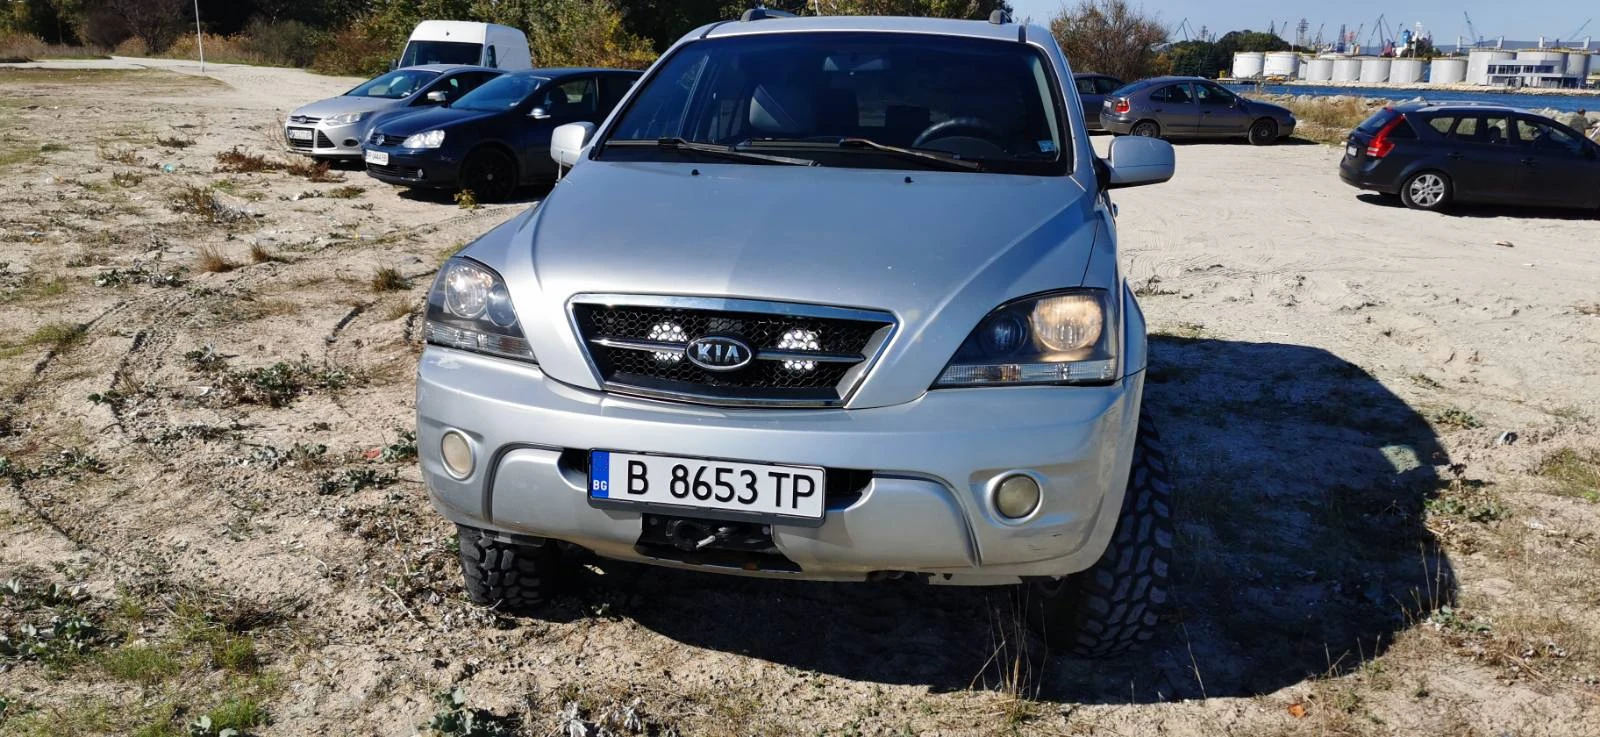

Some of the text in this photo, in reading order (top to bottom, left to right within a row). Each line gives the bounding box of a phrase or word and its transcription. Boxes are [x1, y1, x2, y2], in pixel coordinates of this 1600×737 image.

[697, 343, 740, 362] KIA
[592, 479, 608, 491] BG
[627, 460, 815, 509] B 8653 TP
